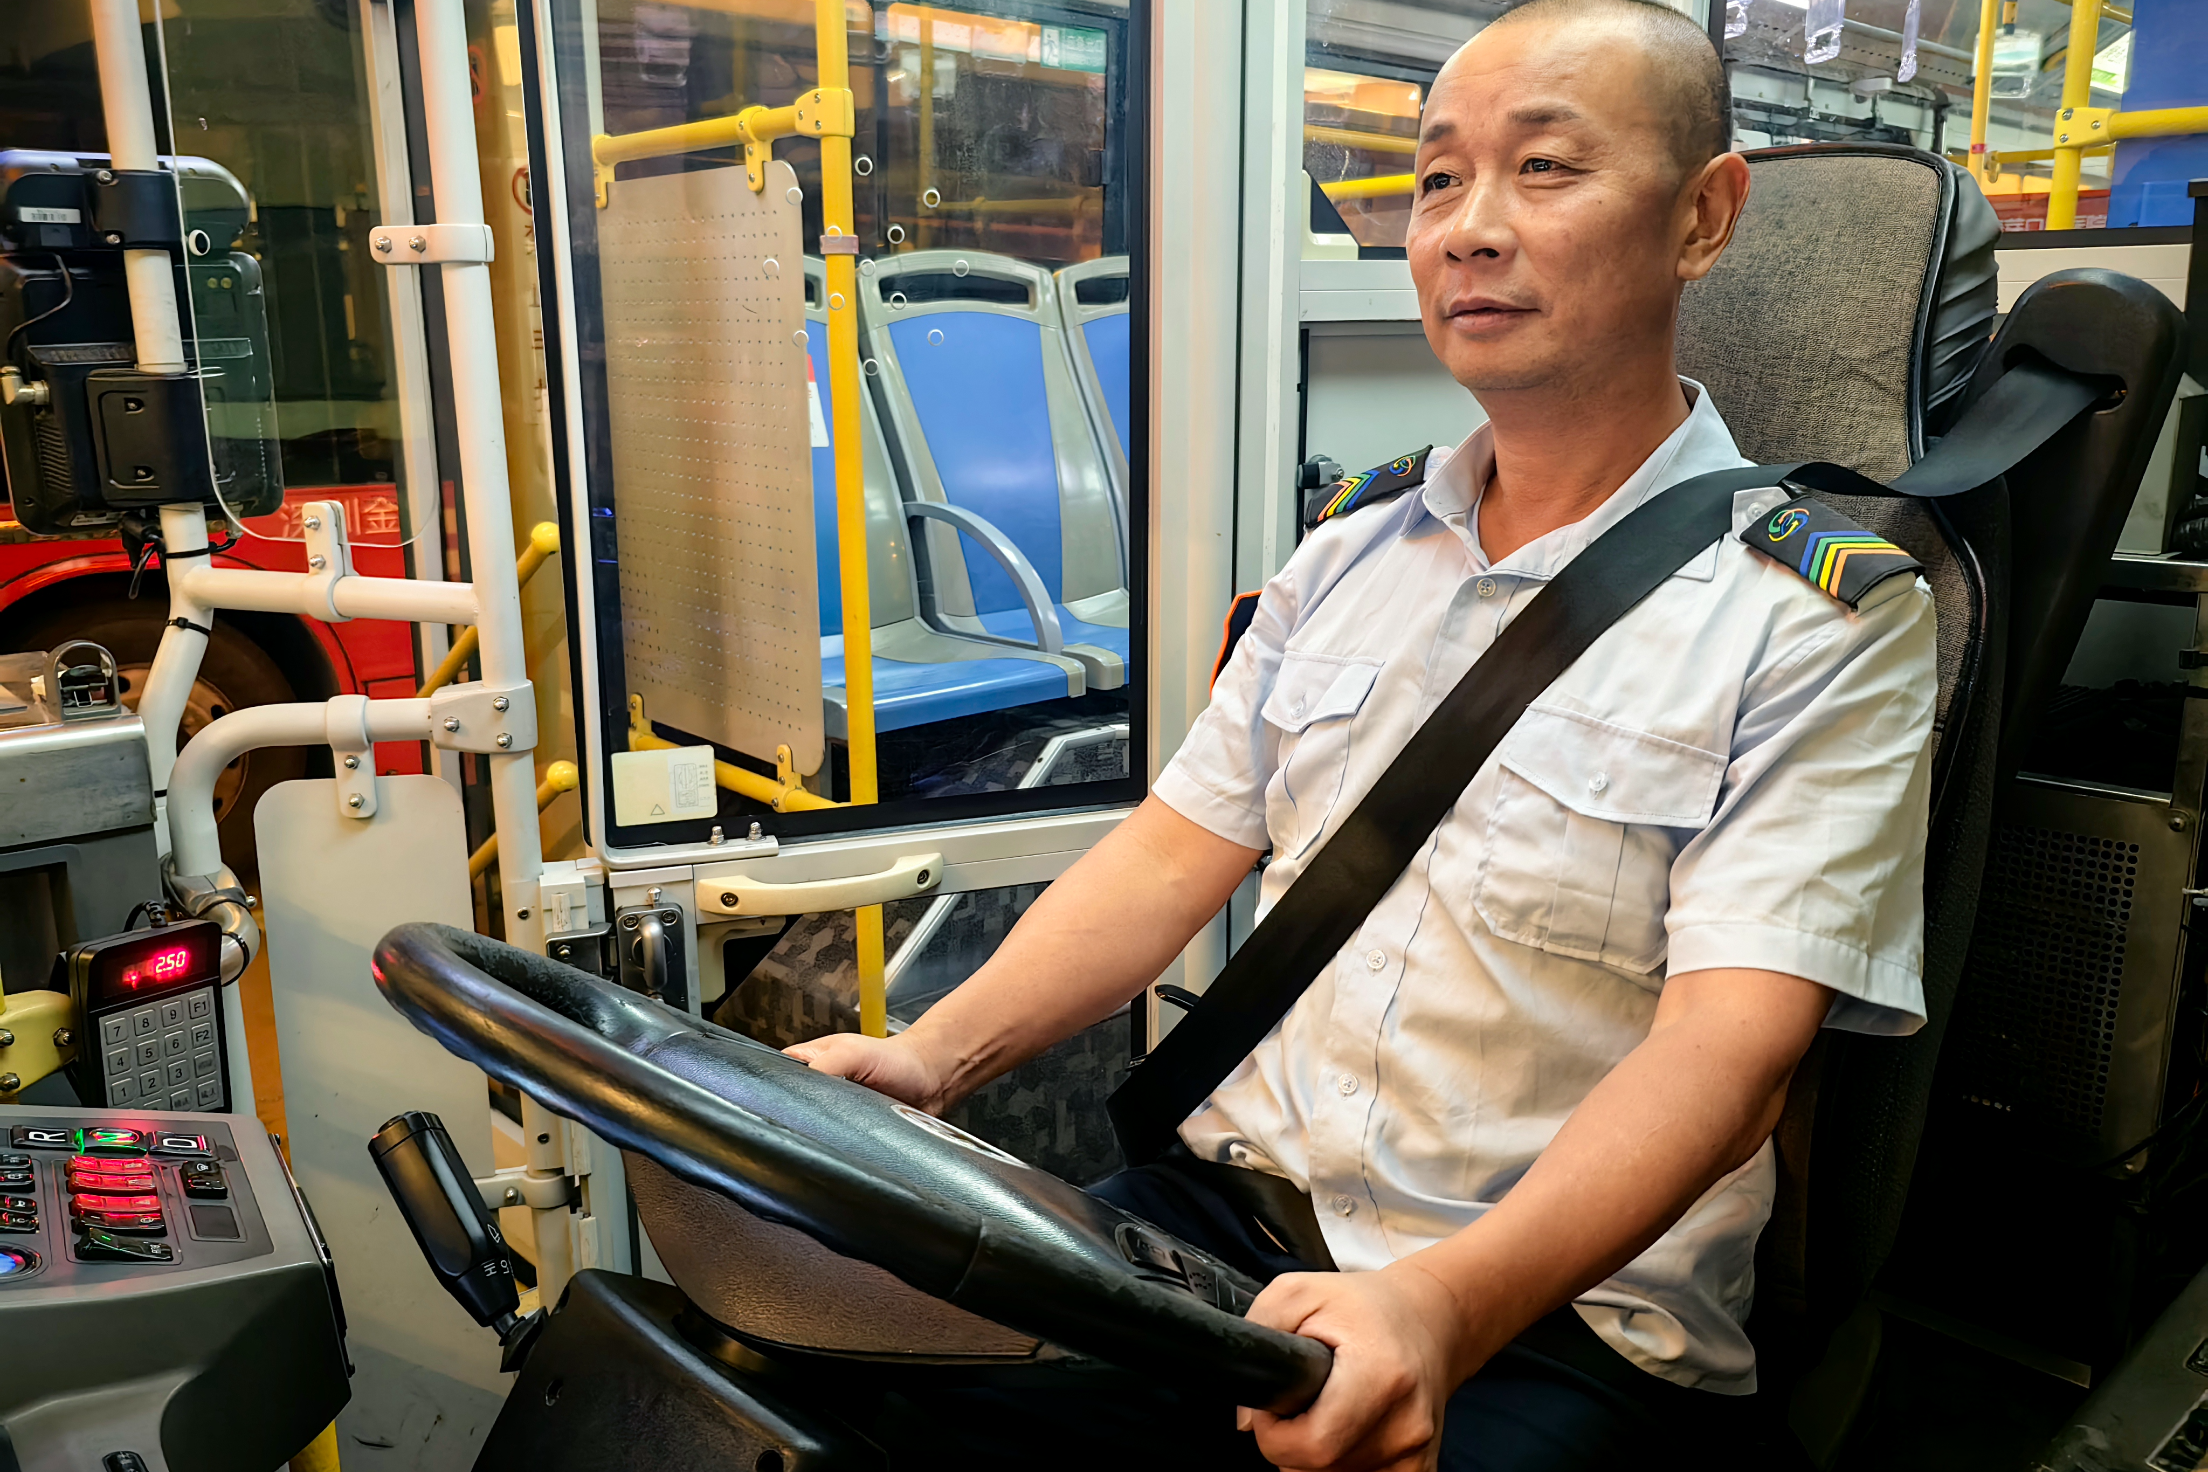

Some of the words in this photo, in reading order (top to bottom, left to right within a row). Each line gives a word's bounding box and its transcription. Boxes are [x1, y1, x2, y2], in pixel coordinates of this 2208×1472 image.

[155, 950, 187, 974] 2.50
[113, 1026, 121, 1038] 7
[142, 1018, 150, 1028] 8
[170, 1009, 177, 1020] 9
[193, 1001, 207, 1013] F1
[117, 1056, 124, 1067] 4
[145, 1048, 153, 1058] 5
[172, 1038, 179, 1048] 6
[195, 1029, 209, 1042] F2
[121, 1087, 127, 1097] 1
[148, 1077, 156, 1089] 2
[175, 1068, 183, 1078] 3
[28, 1131, 66, 1142] R
[96, 1131, 134, 1143] N
[162, 1138, 198, 1149] D
